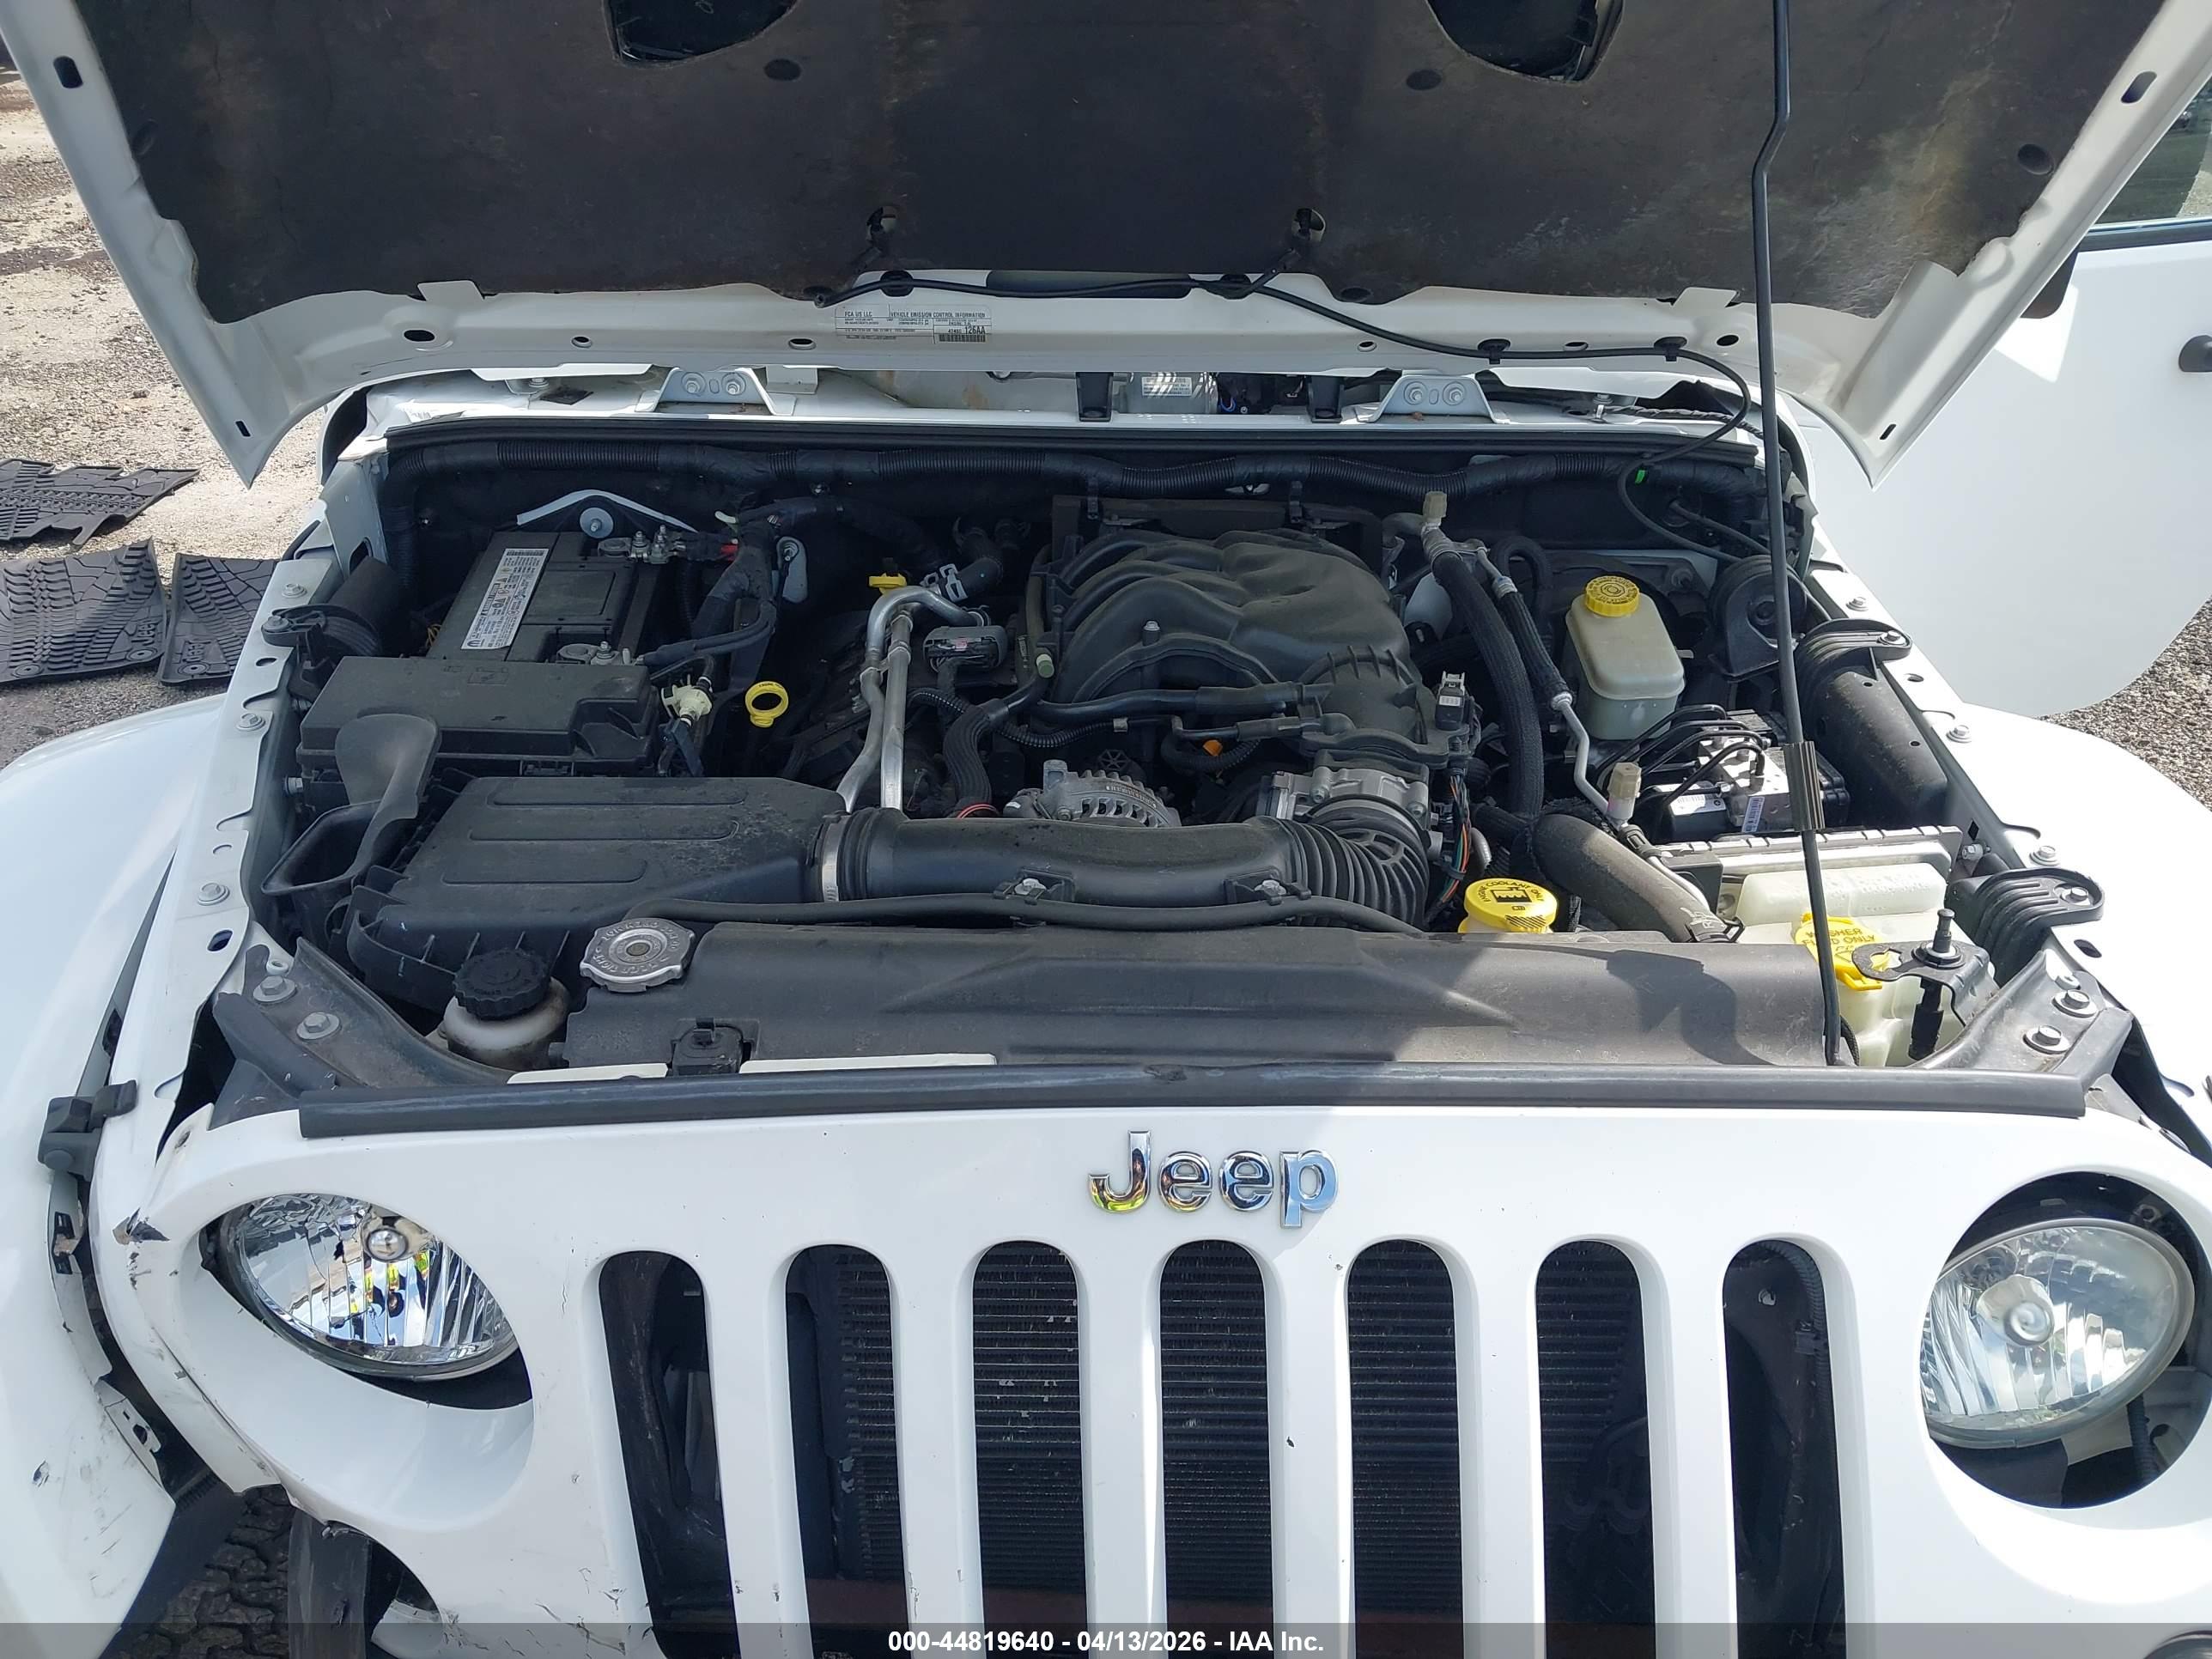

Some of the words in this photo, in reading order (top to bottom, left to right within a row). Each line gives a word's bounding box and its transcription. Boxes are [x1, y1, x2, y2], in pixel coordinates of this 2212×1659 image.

[964, 325, 986, 335] 126AA
[1486, 880, 1531, 890] COOLANT
[1843, 934, 1875, 944] ONLY
[1088, 1130, 1339, 1228] Jeep
